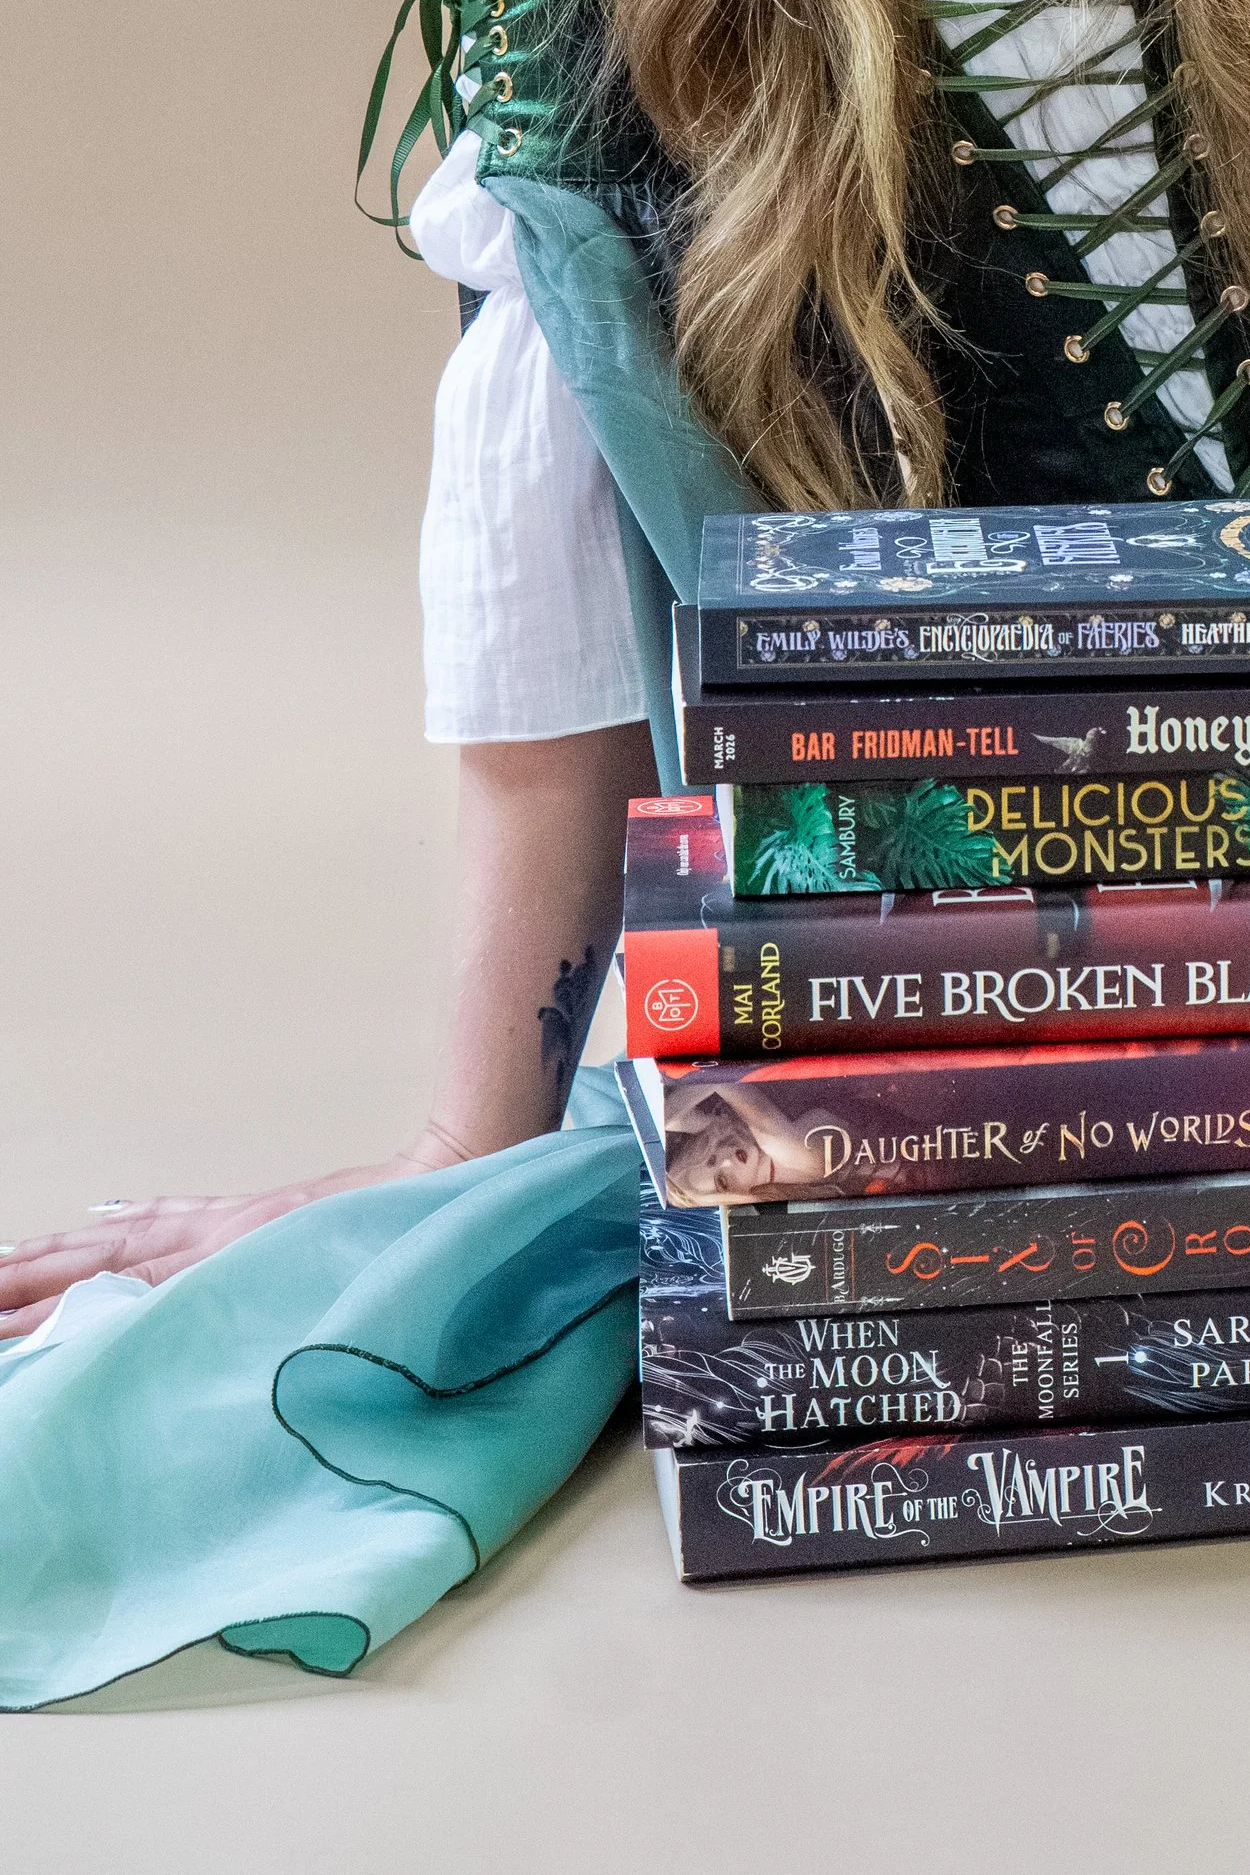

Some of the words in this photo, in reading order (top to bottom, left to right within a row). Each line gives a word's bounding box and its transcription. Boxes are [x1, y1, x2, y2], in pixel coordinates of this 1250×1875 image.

[756, 631, 820, 654] EMILY
[827, 628, 911, 653] WILDE'S
[919, 615, 1054, 661] ENCYCLOPAEDIA
[1058, 632, 1074, 645] OF
[1077, 621, 1160, 655] FAERIES
[714, 727, 724, 769] MARCH
[725, 734, 736, 761] 2026
[791, 732, 836, 761] BAR
[852, 726, 1020, 760] FRIDMAN-TELL
[966, 777, 1249, 832] DELICIOUS
[839, 795, 856, 880] SAMBURY
[733, 983, 753, 1025] MAI
[760, 942, 785, 1050] CORLAND
[808, 973, 923, 1022] FIVE
[940, 963, 1165, 1023] BROKEN
[804, 1121, 1021, 1178] DAUGHTER
[1018, 1122, 1050, 1154] of
[1058, 1110, 1114, 1161] NO
[831, 1230, 849, 1303] BARDUGO
[886, 1233, 1057, 1280] SIX
[1071, 1231, 1098, 1271] OF
[797, 1318, 900, 1352] WHEN
[1037, 1299, 1053, 1420] MOONFALL
[765, 1363, 806, 1380] THE
[810, 1350, 951, 1389] MOON
[1013, 1341, 1029, 1387] THE
[1062, 1323, 1080, 1398] SERIES
[755, 1390, 962, 1432] HATCHED
[716, 1459, 930, 1546] EMPIRE
[902, 1499, 925, 1523] OF
[927, 1496, 959, 1521] THE
[961, 1445, 1163, 1537] VAMPIRE
